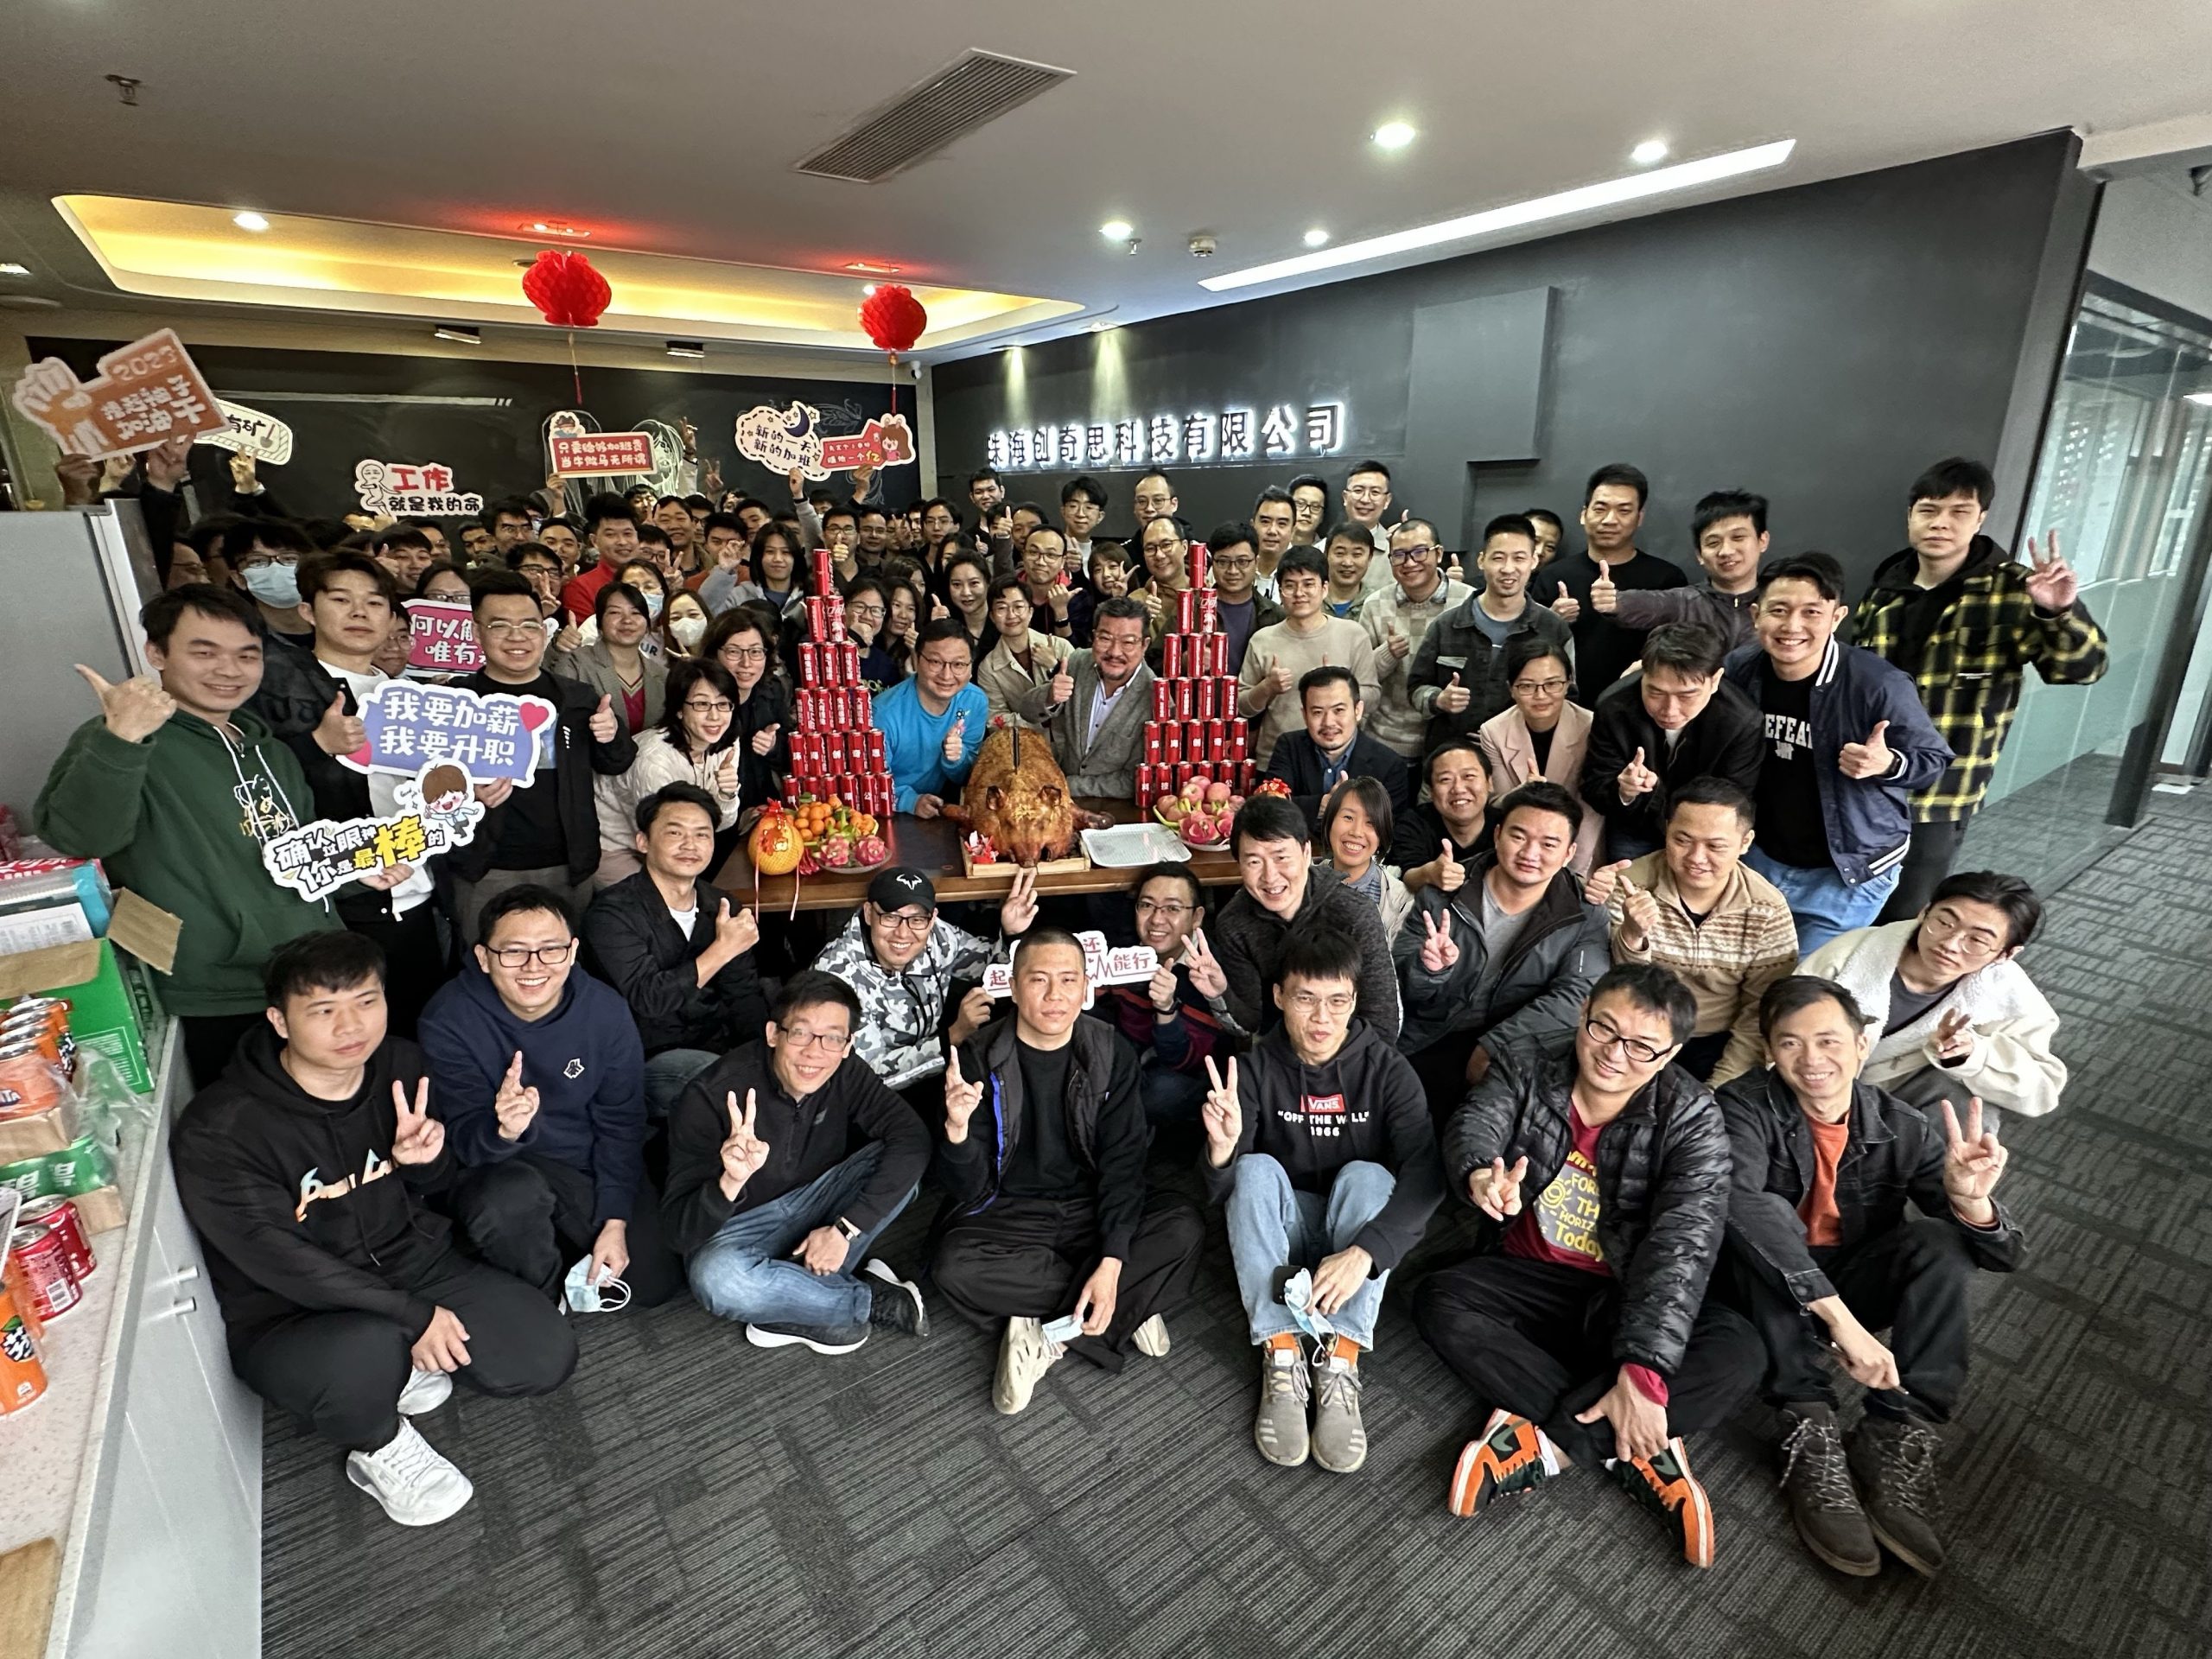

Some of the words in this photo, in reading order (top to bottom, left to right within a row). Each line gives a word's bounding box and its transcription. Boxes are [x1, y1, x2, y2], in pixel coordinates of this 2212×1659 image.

[558, 439, 643, 454] 只要给够加班费
[754, 424, 811, 454] 新的一天
[987, 404, 1344, 466] 珠海创奇思科技有限公司
[561, 453, 646, 468] 当牛做马无所谓
[753, 438, 811, 467] 新的加班
[391, 467, 450, 492] 工作
[388, 496, 480, 512] 就是我的命
[424, 640, 487, 664] 唯有
[384, 690, 519, 736] 我要加薪
[379, 724, 516, 766] 我要升职
[297, 815, 447, 893] 你是最棒的
[1113, 952, 1151, 971] 能行
[1307, 1096, 1340, 1110] VANS
[1309, 1114, 1332, 1125] THE
[1310, 1126, 1340, 1137] 1966
[1577, 1196, 1601, 1219] TH
[1559, 1210, 1597, 1232] HORIZ
